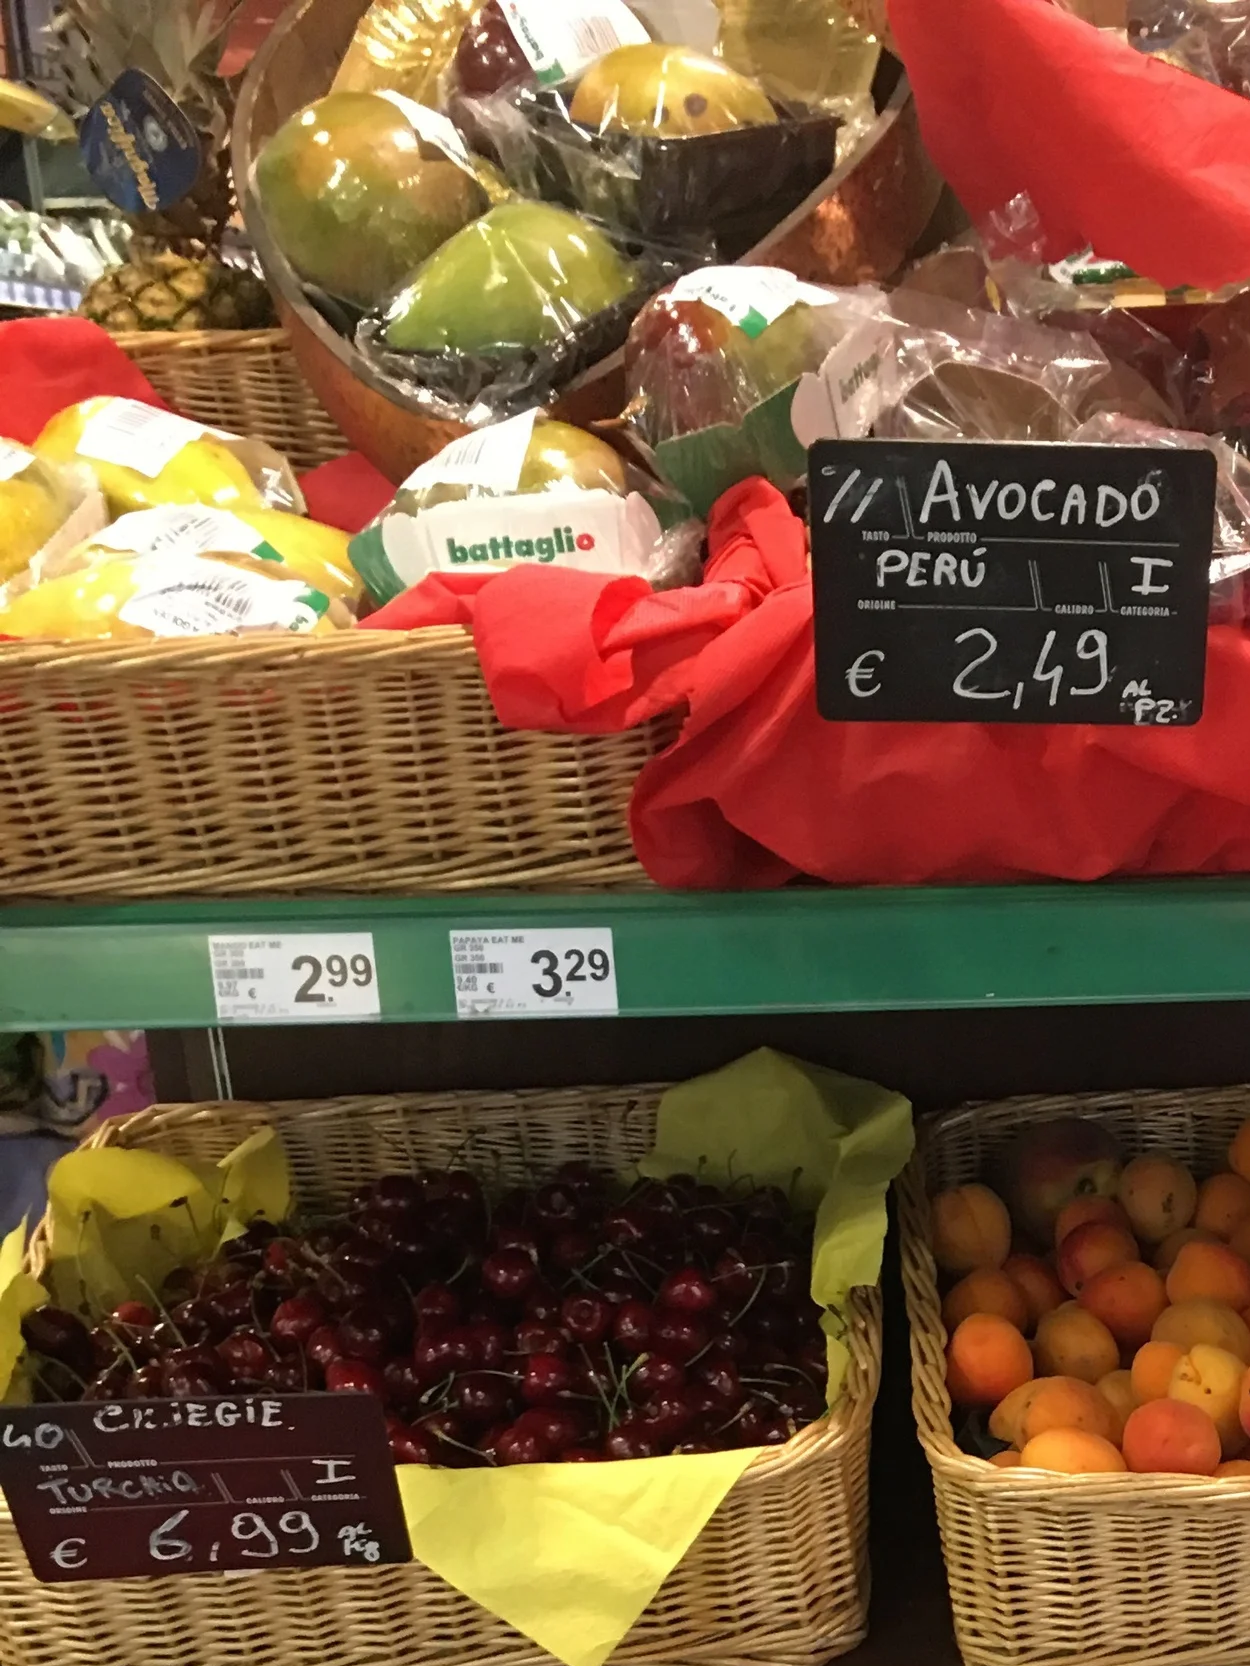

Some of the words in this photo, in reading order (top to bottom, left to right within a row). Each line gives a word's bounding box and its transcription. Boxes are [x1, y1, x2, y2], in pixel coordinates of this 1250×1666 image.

[919, 459, 1161, 528] AVOCADO
[446, 526, 595, 563] battaglio
[927, 531, 977, 544] PRODOTTO
[876, 547, 987, 588] PERÚ
[1130, 556, 1174, 595] I
[858, 600, 896, 611] ORIGINE
[1055, 604, 1094, 615] CALIBRO
[1120, 606, 1170, 617] CATEGORIA
[845, 650, 885, 698] €
[953, 627, 1109, 710] 2,49
[1122, 680, 1152, 698] AL
[453, 937, 489, 945] PAPAYA
[491, 936, 509, 944] EAT
[291, 953, 373, 1003] 2.99
[486, 983, 495, 993] €
[531, 948, 610, 998] 3.29
[311, 1459, 356, 1485] I
[49, 1538, 88, 1570] €
